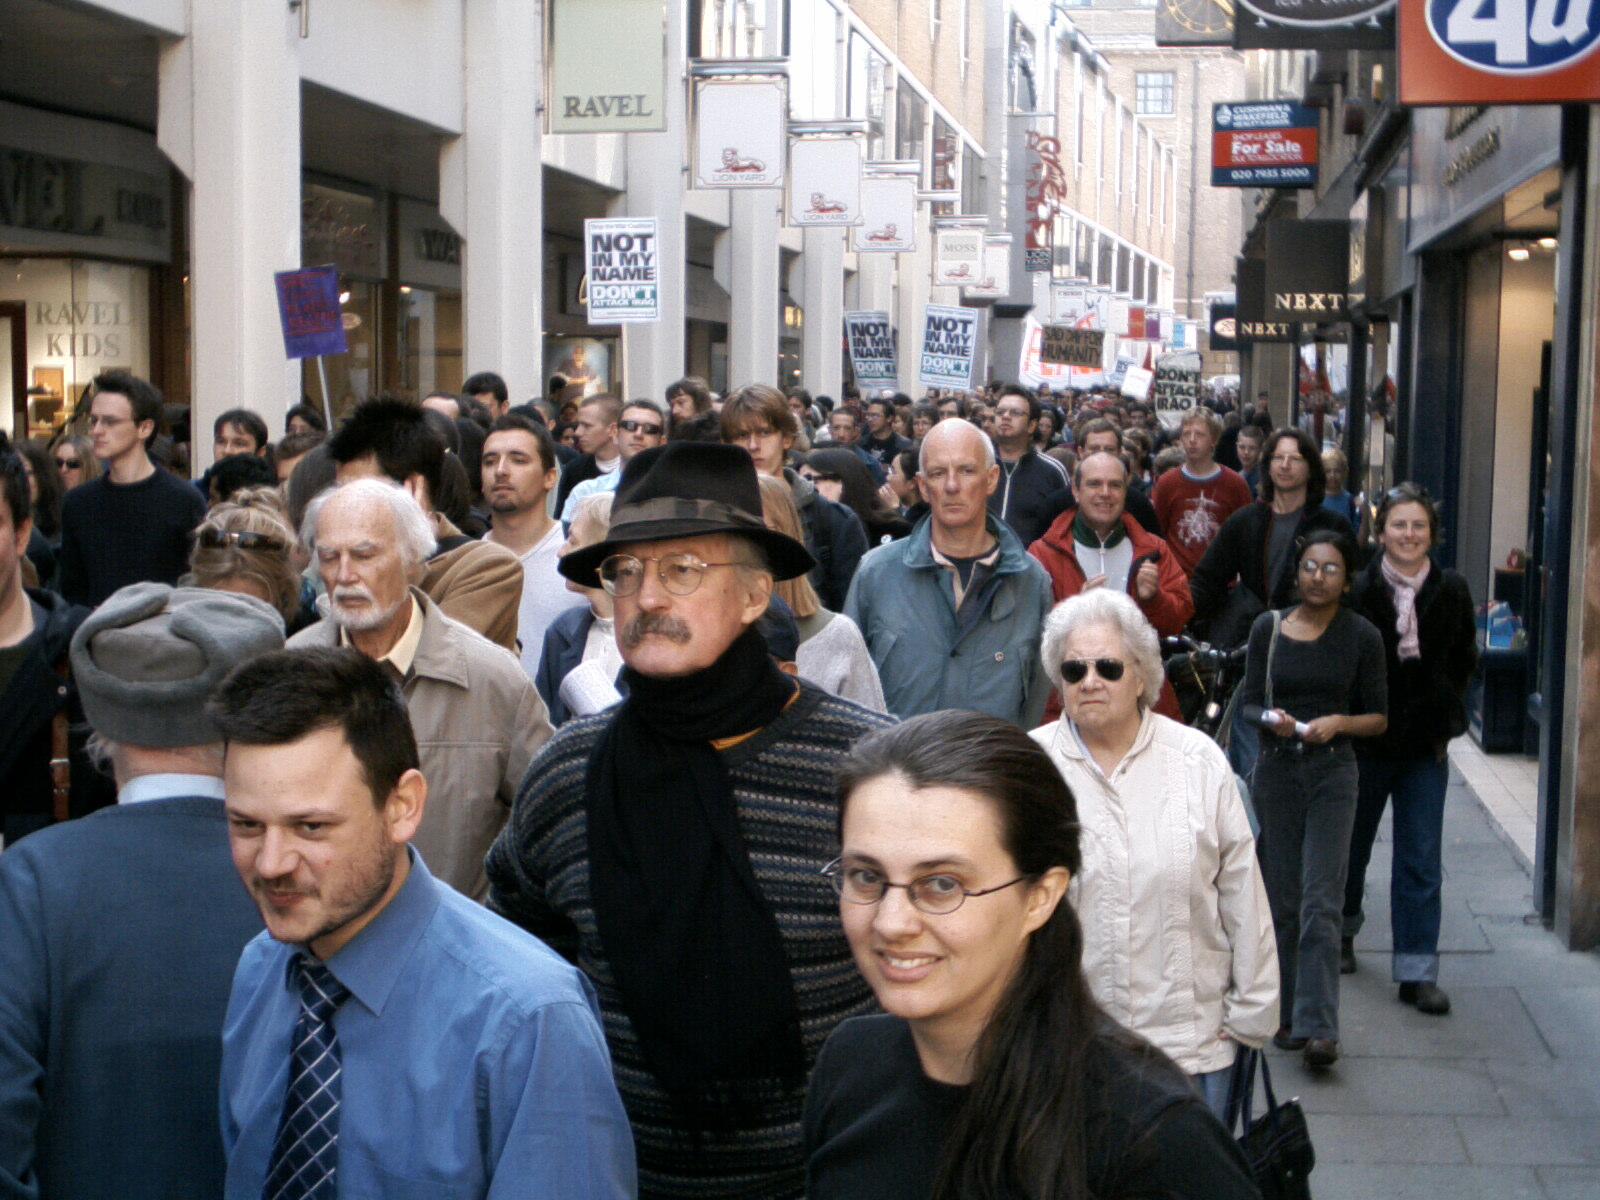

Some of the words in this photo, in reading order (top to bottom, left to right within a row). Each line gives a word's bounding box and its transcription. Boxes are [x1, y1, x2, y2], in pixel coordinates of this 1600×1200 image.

[562, 94, 653, 118] RAVEL
[1232, 112, 1289, 121] WAKEFIELD
[1231, 141, 1261, 155] For
[1264, 139, 1301, 153] Sale
[712, 174, 736, 182] LION
[738, 173, 766, 182] YARD
[1231, 169, 1252, 179] 020
[1280, 167, 1310, 178] 5000
[803, 213, 824, 221] LION
[825, 213, 848, 221] YARD
[592, 233, 654, 252] NOT
[943, 243, 977, 253] MOSS
[592, 252, 612, 266] IN
[620, 252, 653, 266] MY
[592, 267, 654, 280] NAME
[592, 285, 655, 299] DON'T
[1275, 293, 1344, 310] NEXT
[35, 301, 128, 325] RAVEL
[851, 322, 888, 336] NOT
[927, 316, 973, 334] NOT
[1241, 322, 1290, 335] NEXT
[853, 336, 867, 347] IN
[870, 336, 890, 348] MY
[925, 330, 941, 342] IN
[945, 332, 971, 345] MY
[1044, 326, 1064, 341] SAD
[1085, 330, 1104, 345] FOR
[46, 332, 121, 358] KIDS
[854, 347, 894, 358] NAME
[924, 342, 971, 357] NAME
[1042, 341, 1102, 366] HUMANITY
[923, 356, 970, 371] DON'T
[1156, 367, 1201, 383] DON'T
